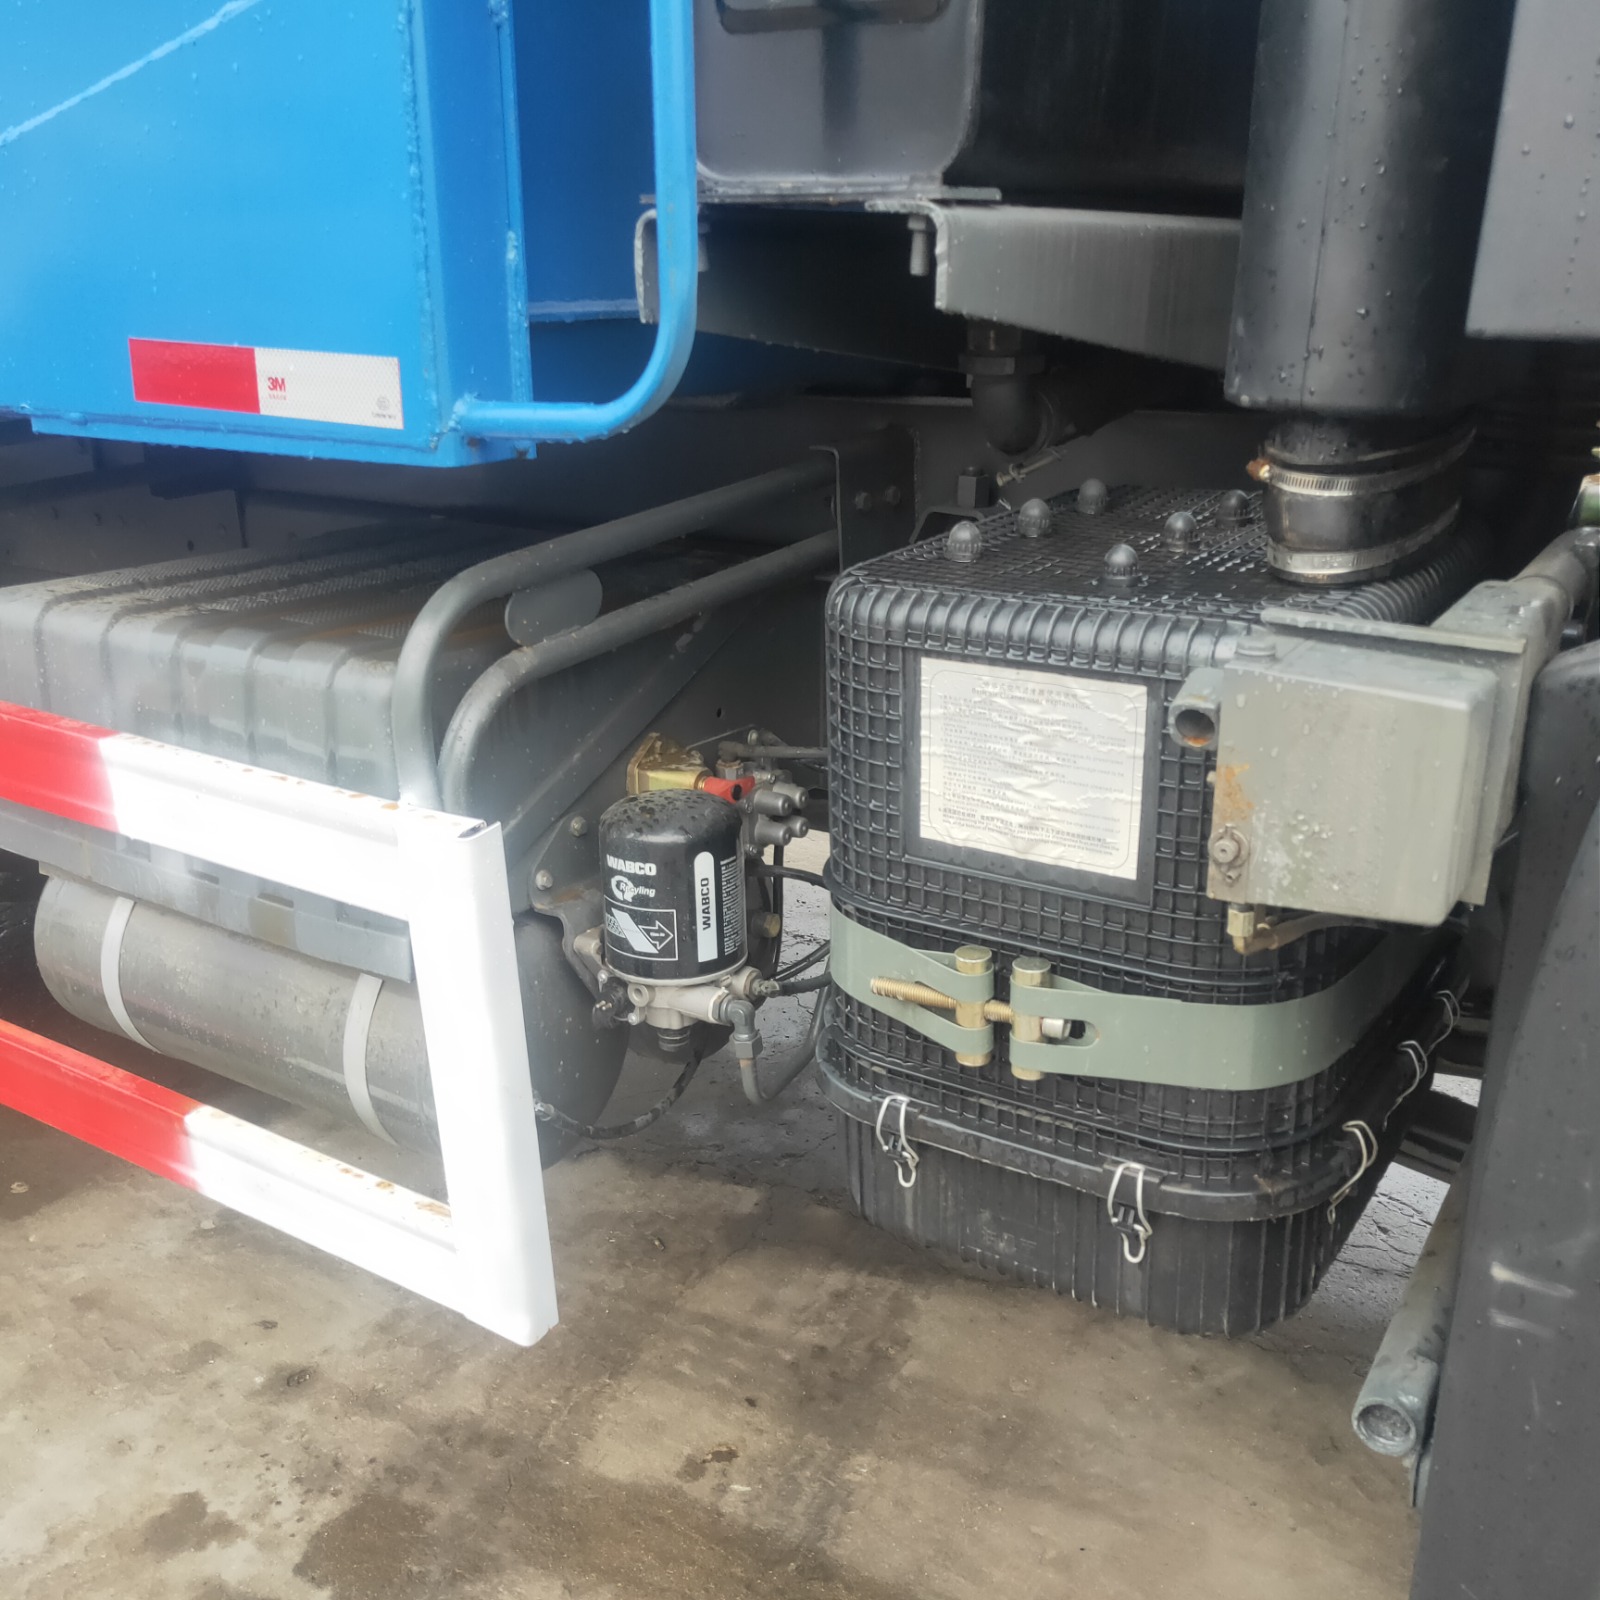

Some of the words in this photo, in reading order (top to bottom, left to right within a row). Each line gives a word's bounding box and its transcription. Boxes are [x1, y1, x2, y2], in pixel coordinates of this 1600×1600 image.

[268, 377, 286, 392] 3M
[606, 853, 657, 876] WABCO
[700, 877, 712, 931] WABCO
